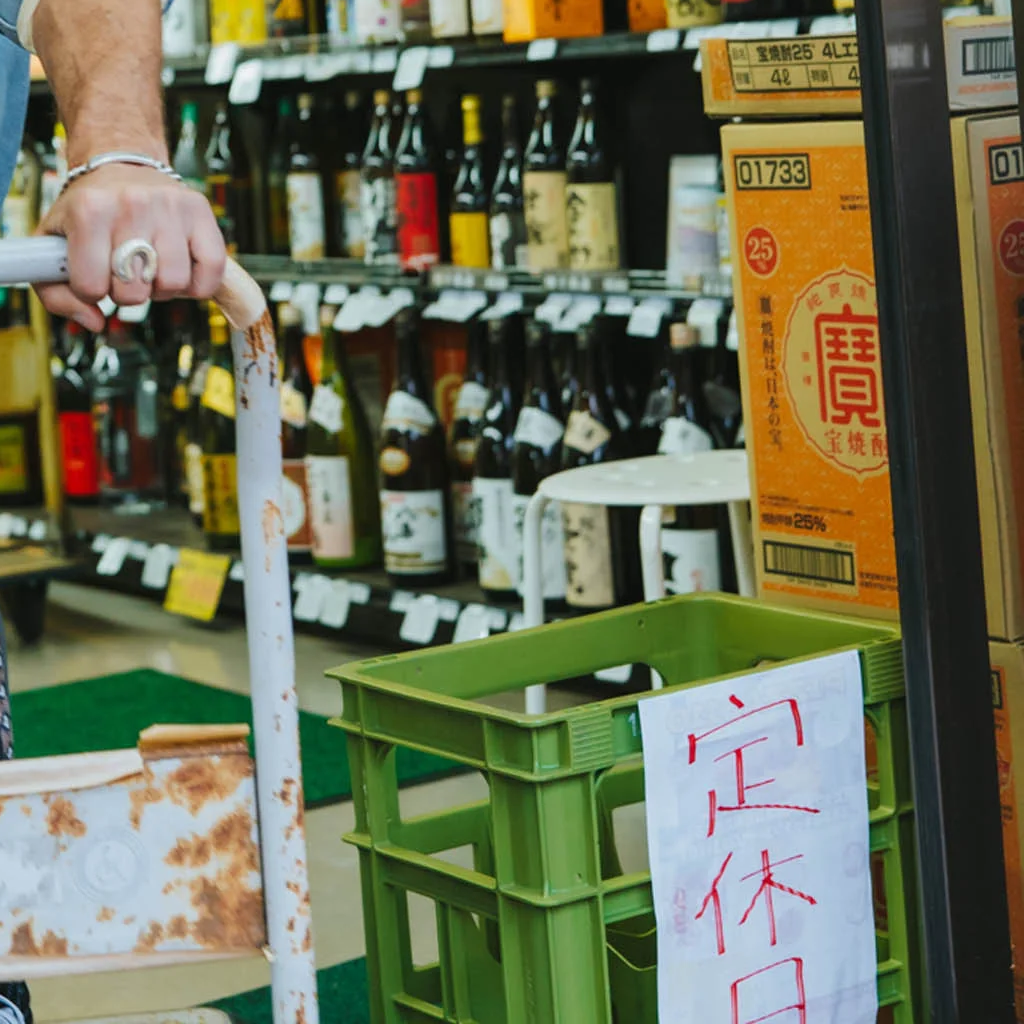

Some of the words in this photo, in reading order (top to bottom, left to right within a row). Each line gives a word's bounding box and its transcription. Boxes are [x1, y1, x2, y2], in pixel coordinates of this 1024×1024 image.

[739, 159, 807, 186] 01733
[748, 235, 774, 261] 25
[688, 694, 820, 1024] 定休日
